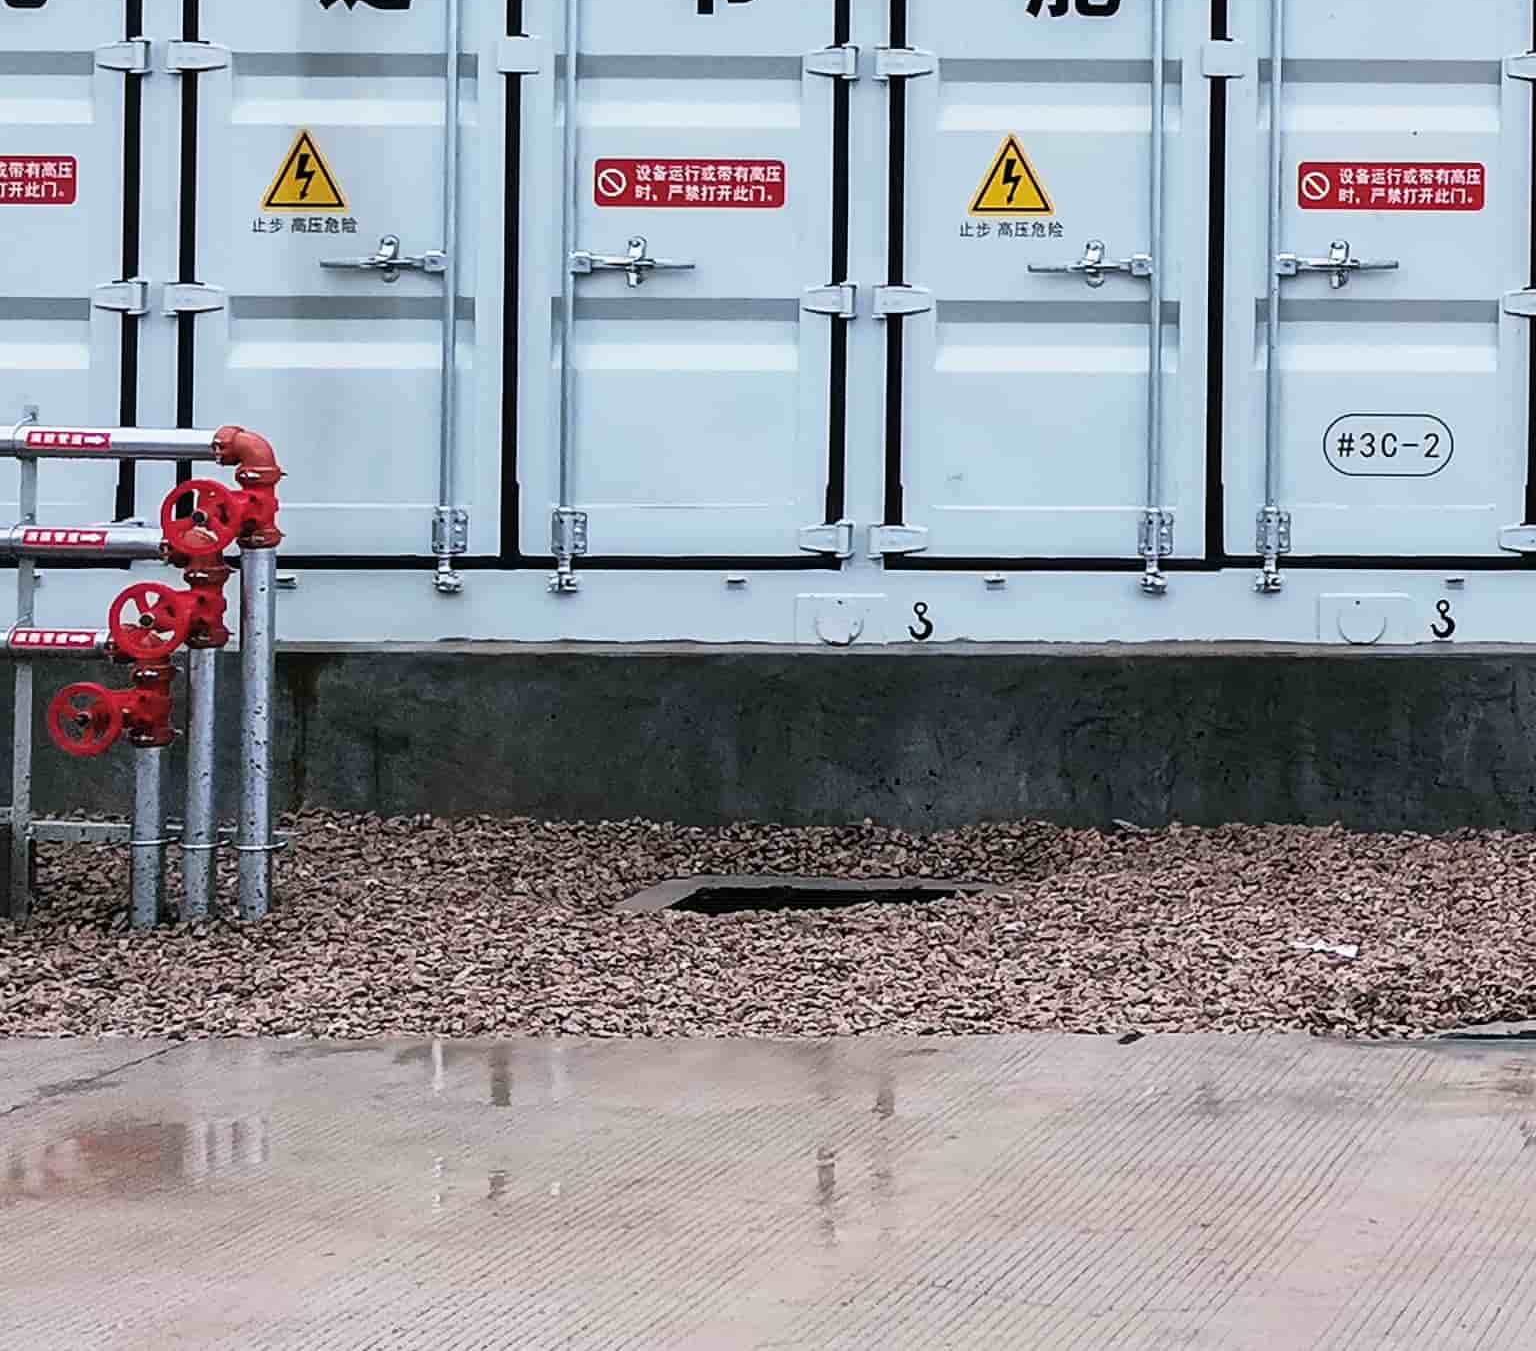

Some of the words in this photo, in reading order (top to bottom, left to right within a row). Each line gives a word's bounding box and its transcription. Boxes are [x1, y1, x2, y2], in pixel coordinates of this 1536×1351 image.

[959, 220, 992, 238] 止步
[998, 220, 1064, 238] 高压危险
[1337, 432, 1440, 458] #3C-2
